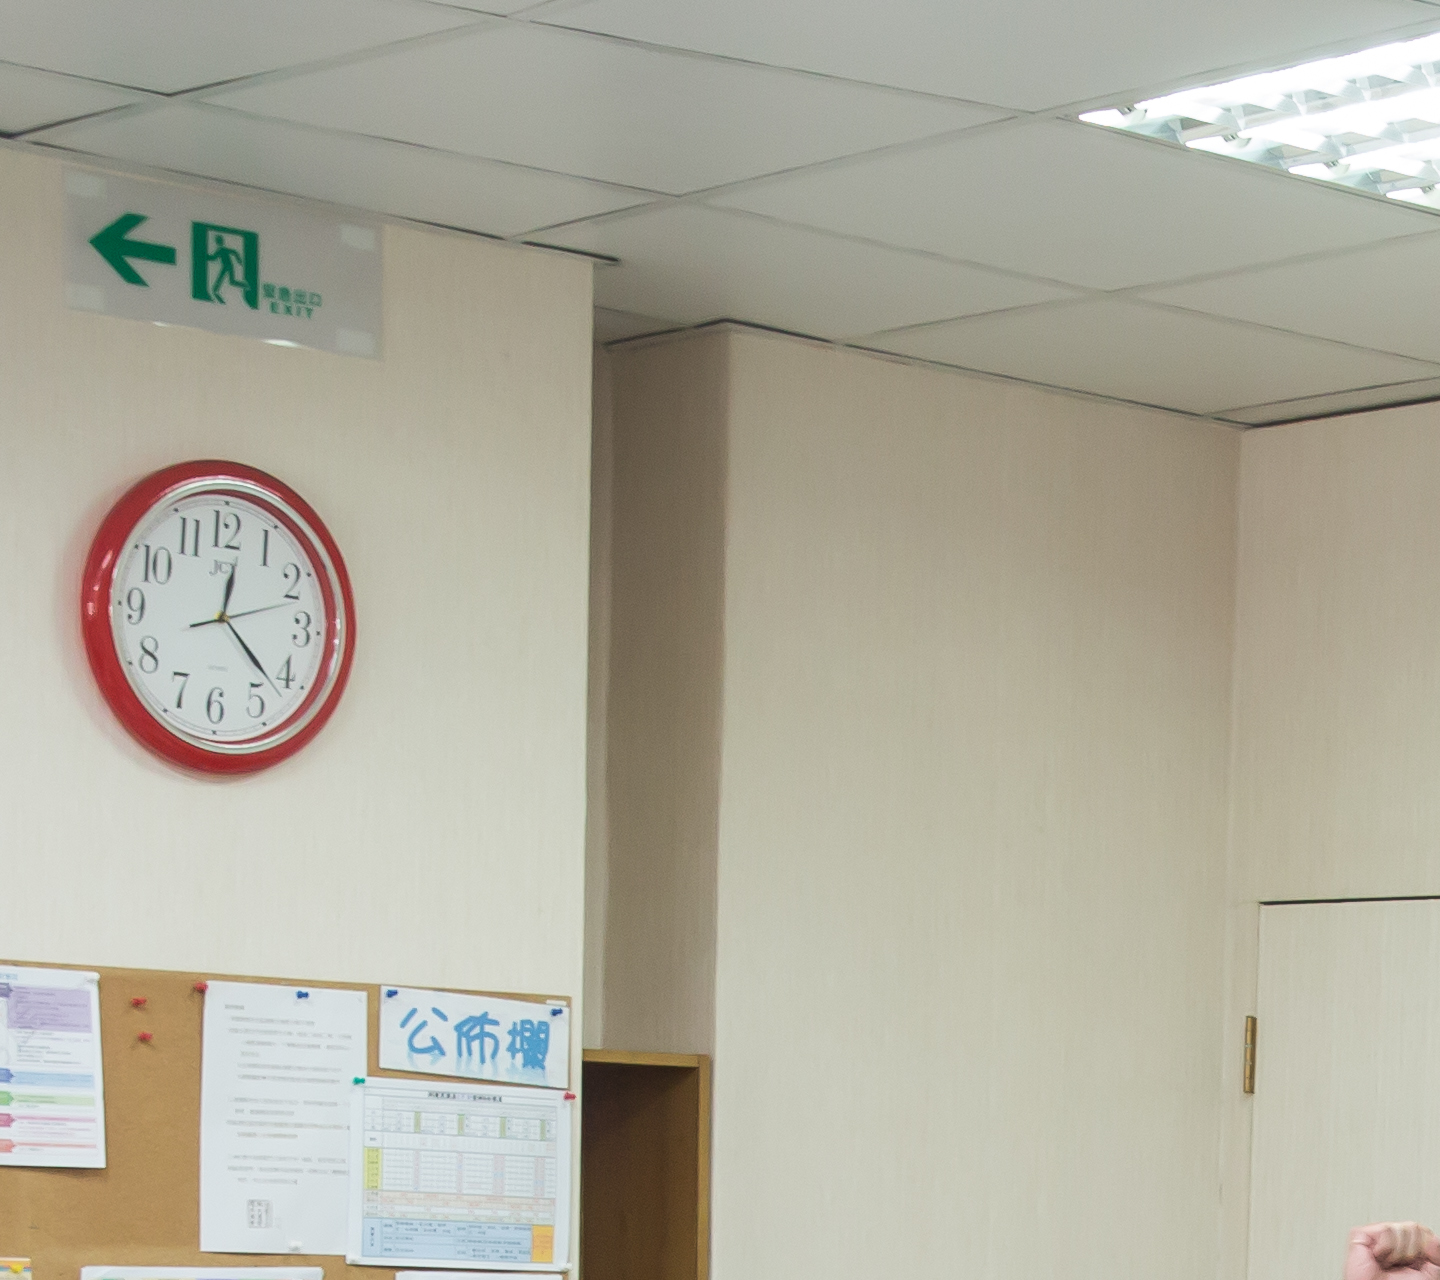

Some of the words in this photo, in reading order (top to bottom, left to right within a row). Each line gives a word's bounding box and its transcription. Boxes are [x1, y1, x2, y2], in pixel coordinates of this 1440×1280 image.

[263, 283, 322, 307] 緊急出口
[270, 301, 314, 319] EXIT
[178, 516, 201, 557] 11
[211, 509, 241, 550] 12
[260, 529, 270, 567] 1
[142, 544, 173, 585] 10
[283, 562, 301, 600] 2
[127, 587, 145, 626] 9
[292, 611, 312, 648] 3
[139, 635, 159, 674] 8
[276, 655, 296, 689] 4
[172, 671, 190, 709] 7
[206, 687, 224, 724] 6
[246, 682, 265, 718] 5
[399, 1006, 551, 1070] 公佈欄
